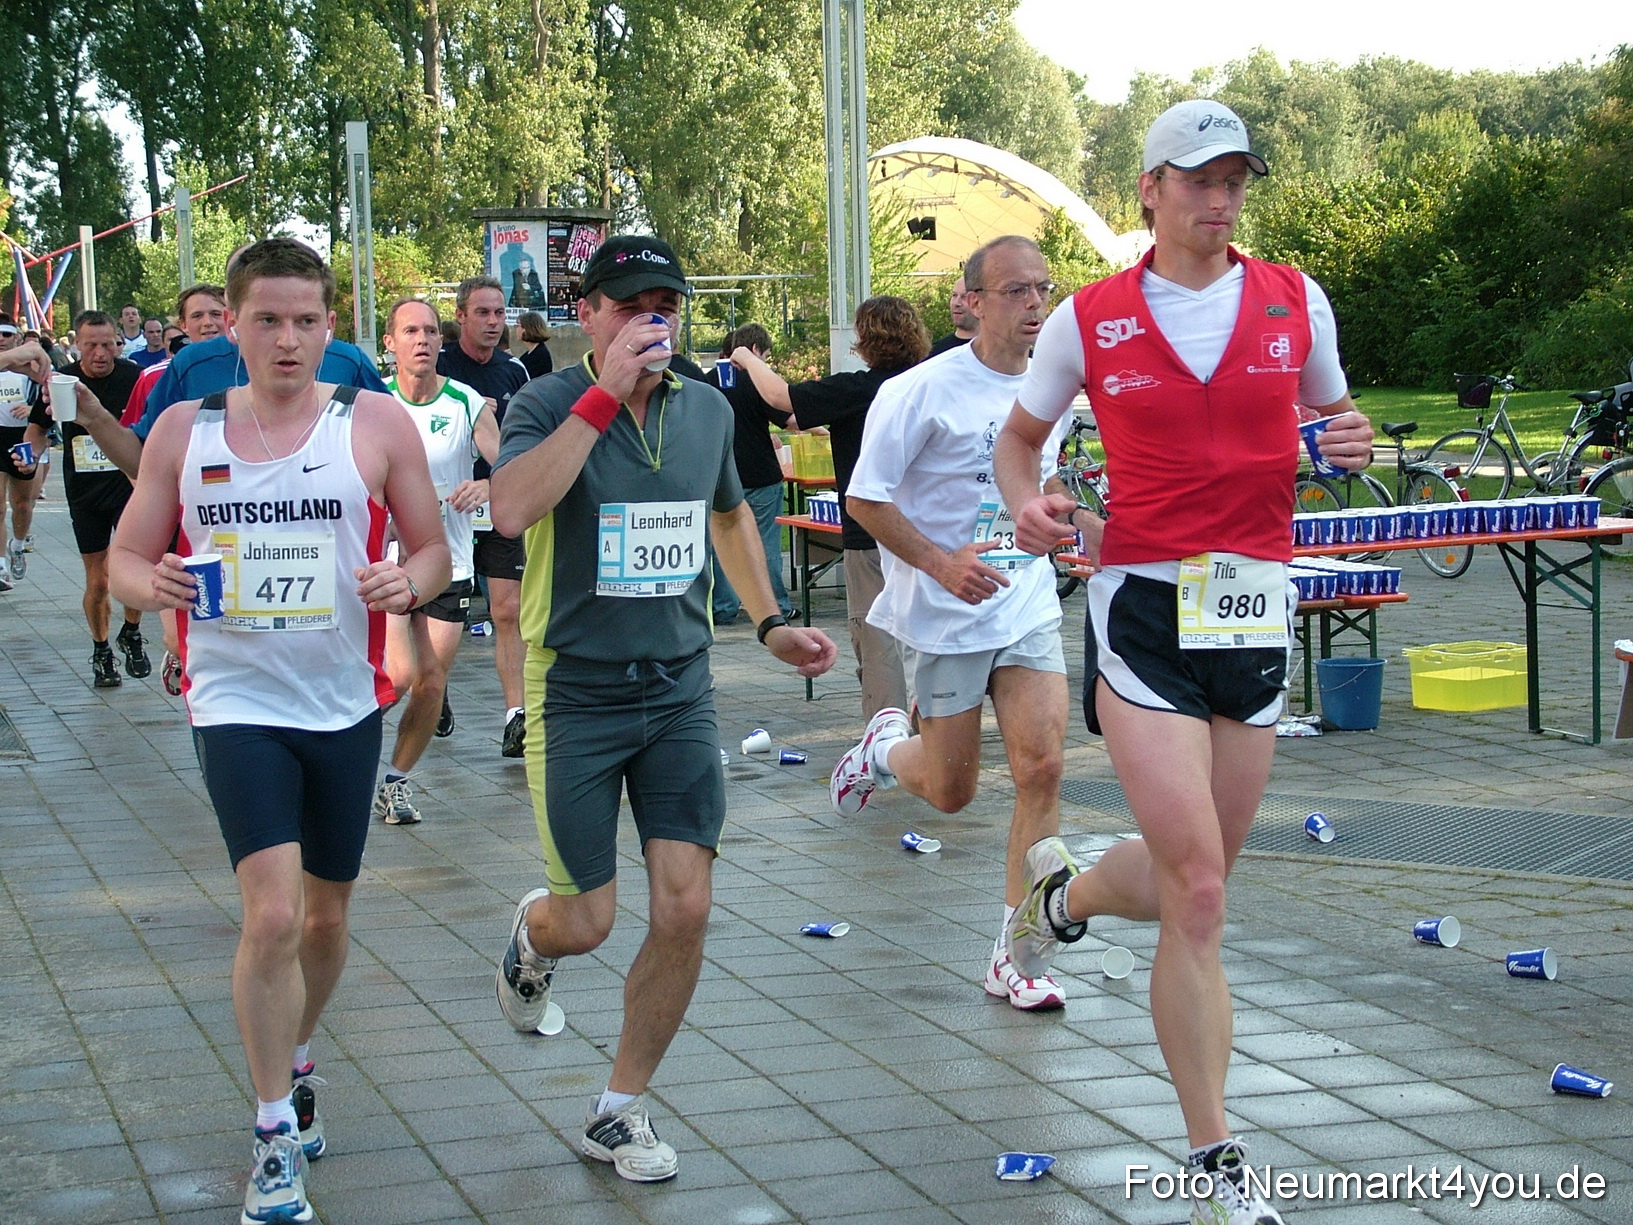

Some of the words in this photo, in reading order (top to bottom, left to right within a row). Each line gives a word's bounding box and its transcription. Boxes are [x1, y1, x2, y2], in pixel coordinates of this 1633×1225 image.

[493, 229, 529, 249] Jonas
[1096, 316, 1146, 349] SDL
[1269, 337, 1290, 358] GB
[0, 388, 21, 396] 1084
[197, 498, 342, 526] DEUTSCHLAND
[631, 510, 693, 530] Leonhard
[243, 541, 319, 561] Johannes
[604, 540, 611, 554] A
[633, 542, 694, 571] 3001
[1214, 561, 1237, 579] Tilo
[193, 572, 211, 618] Xenofit
[255, 576, 315, 604] 477
[598, 582, 642, 592] BOCK
[1182, 586, 1189, 600] B
[1216, 593, 1267, 619] 980
[287, 614, 332, 624] PFLEIDERER
[1181, 633, 1220, 644] BOCK
